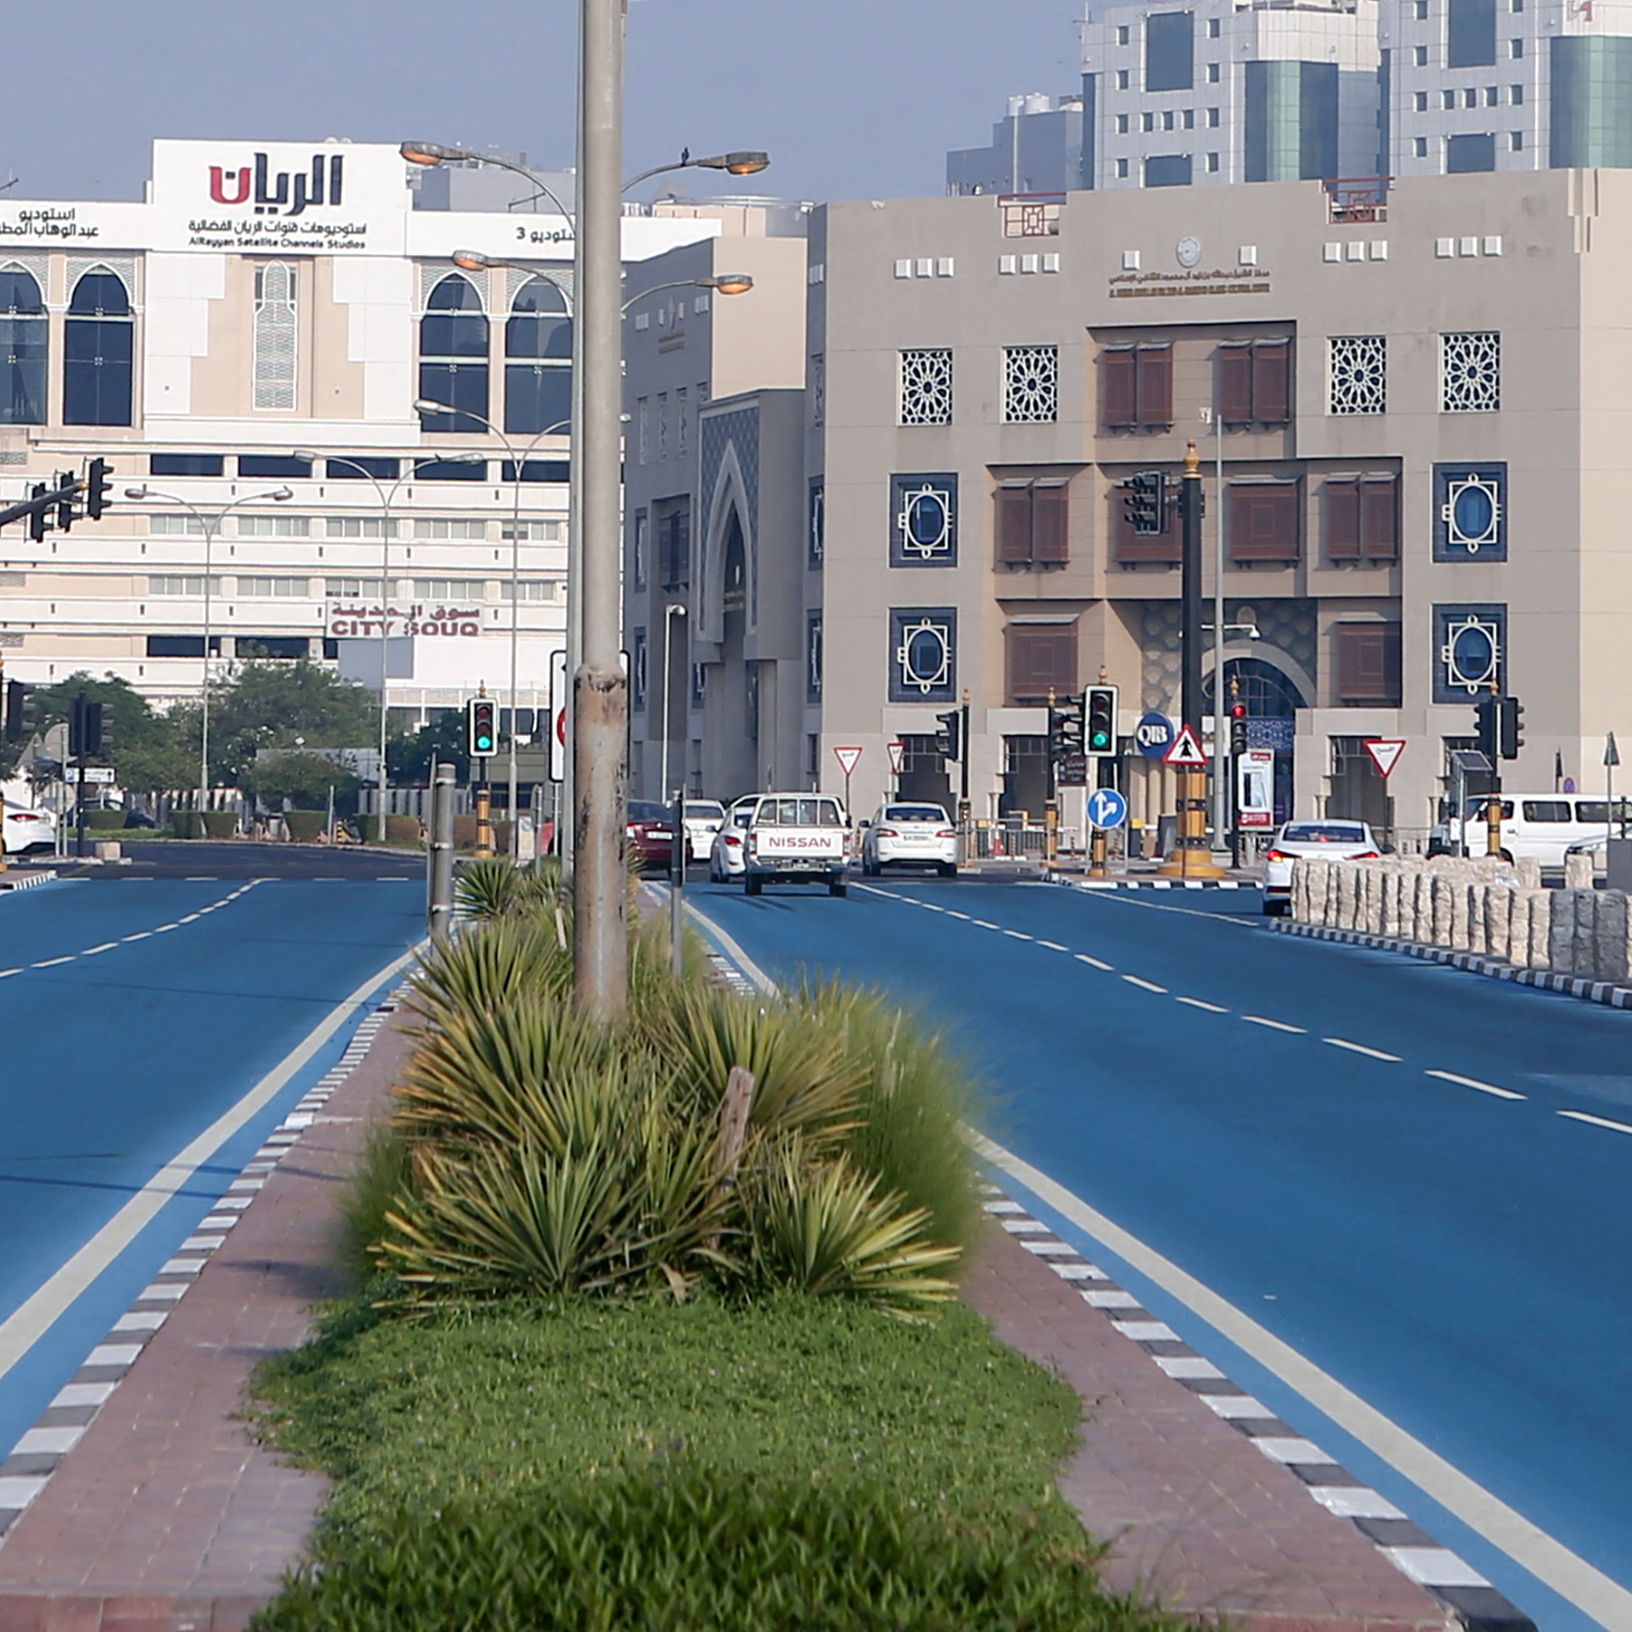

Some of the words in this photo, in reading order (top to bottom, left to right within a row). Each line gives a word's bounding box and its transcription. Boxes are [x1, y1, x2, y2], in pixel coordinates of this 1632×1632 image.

[208, 152, 345, 217] الريان
[19, 207, 76, 222] استوديو
[234, 220, 263, 236] الريان
[515, 226, 526, 240] 3
[237, 237, 279, 247] Satellite
[281, 238, 324, 249] Channels
[327, 239, 366, 249] Studios
[331, 601, 423, 619] المدينة
[429, 605, 480, 621] سوق
[331, 620, 395, 636] CITY
[403, 621, 480, 637] SOUQ
[1137, 724, 1168, 747] QIB
[769, 837, 832, 848] NISSAN
